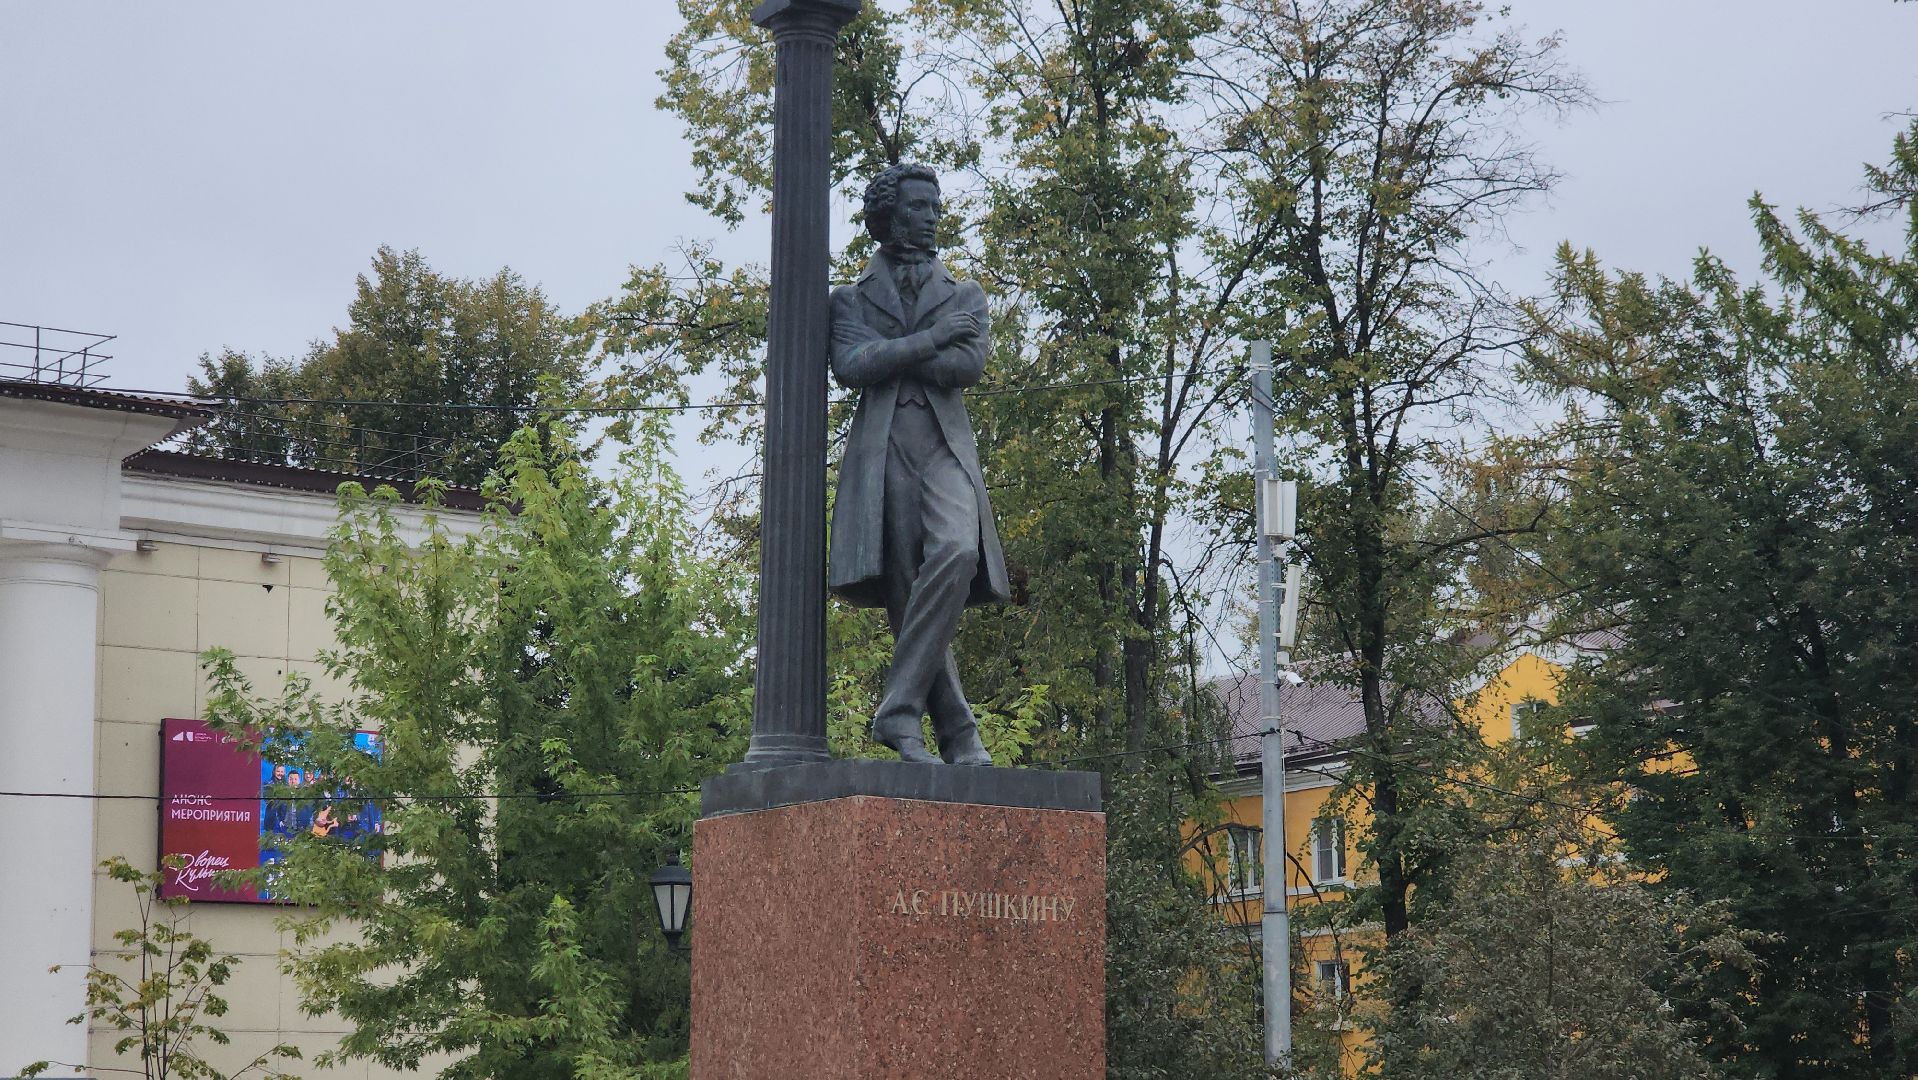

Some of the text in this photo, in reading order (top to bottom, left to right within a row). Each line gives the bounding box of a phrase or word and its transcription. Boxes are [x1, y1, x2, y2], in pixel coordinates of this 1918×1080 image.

[171, 794, 213, 807] АНОНС
[171, 808, 251, 822] МЕРОПРИЯТИЯ
[940, 890, 1076, 922] ПУШКИНУ
